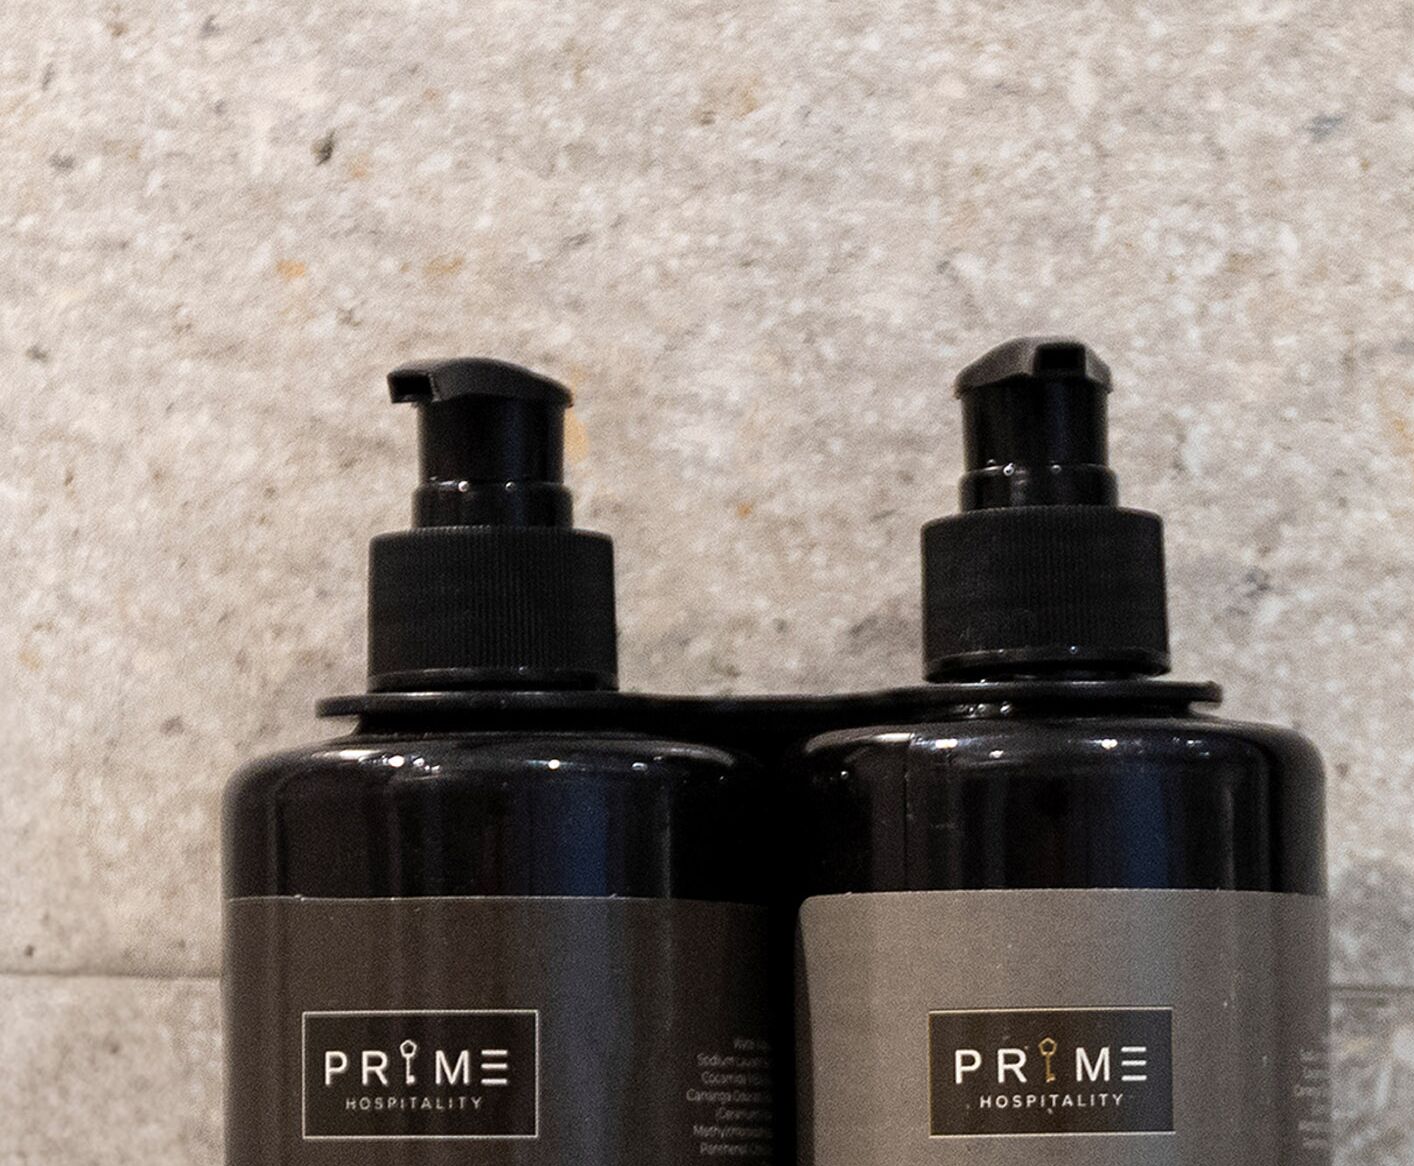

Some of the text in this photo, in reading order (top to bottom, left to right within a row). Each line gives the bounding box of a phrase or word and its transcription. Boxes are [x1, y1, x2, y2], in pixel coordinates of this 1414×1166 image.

[325, 1039, 508, 1085] PRIME
[954, 1037, 1148, 1084] PRIME
[345, 1096, 483, 1111] HOSPITALITY
[979, 1093, 1124, 1109] HOSPITALITY
